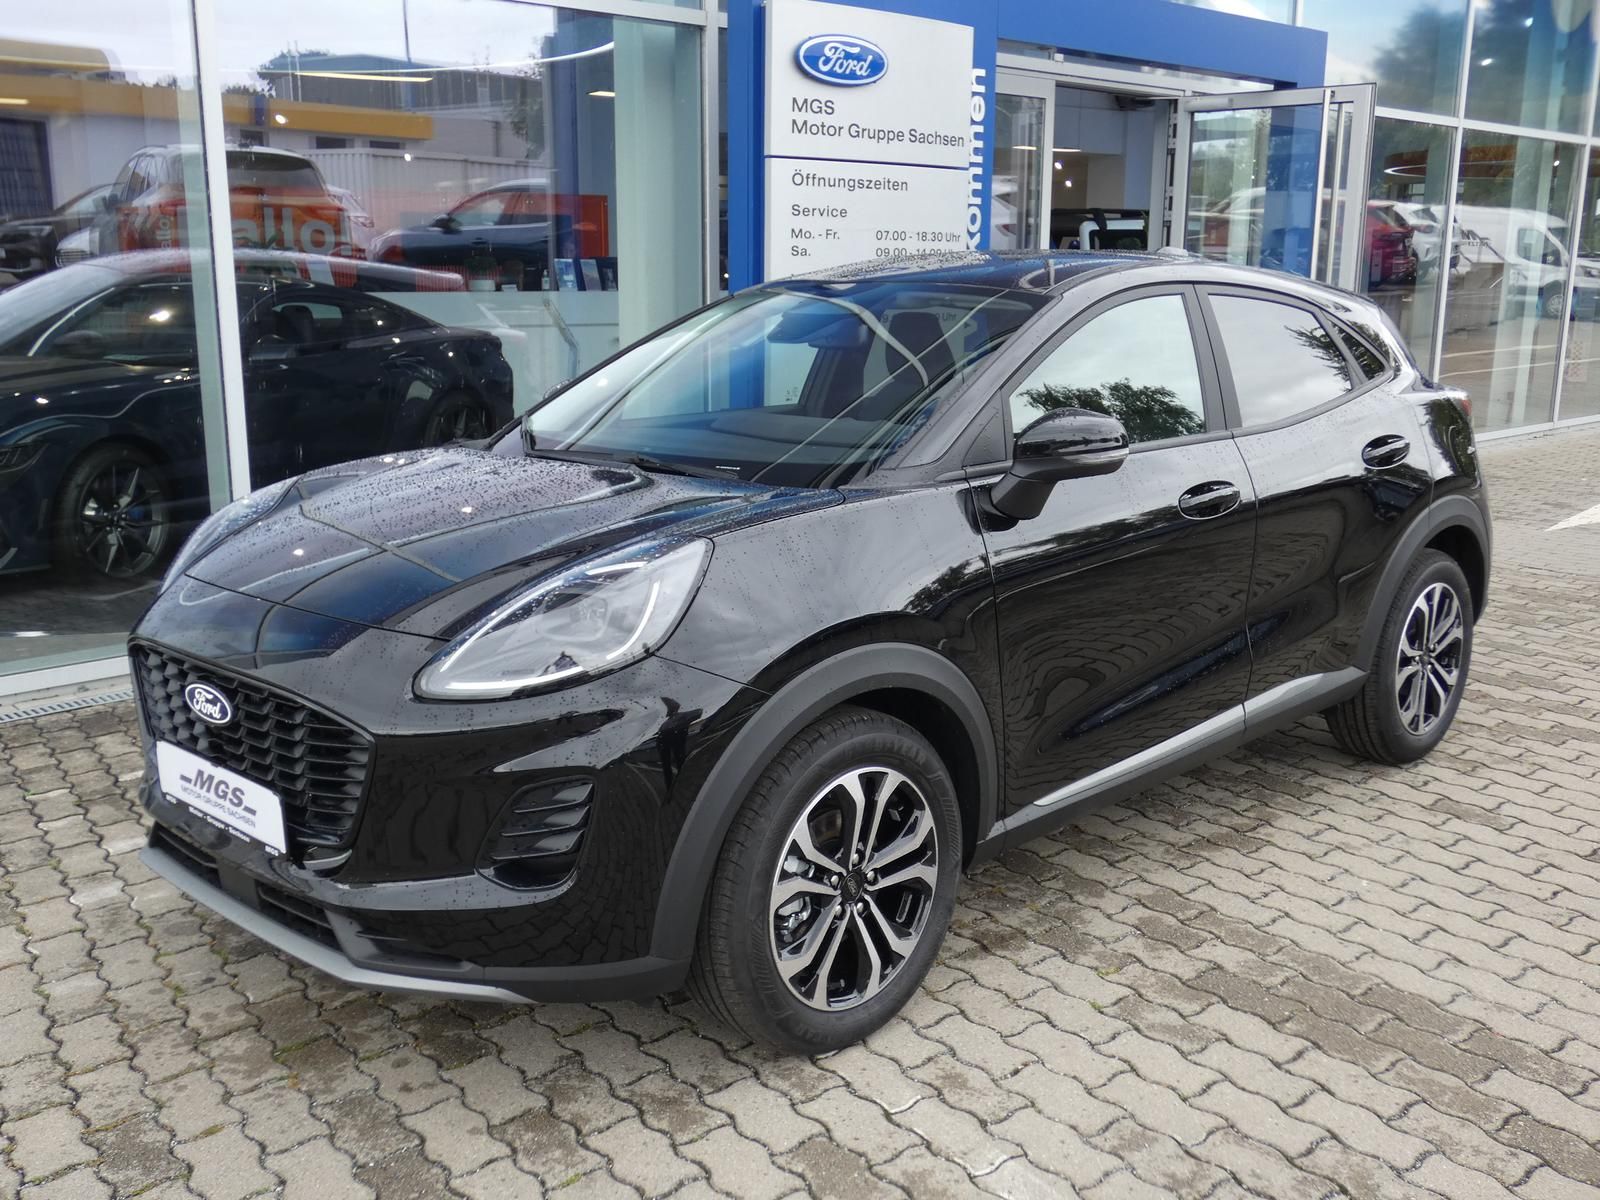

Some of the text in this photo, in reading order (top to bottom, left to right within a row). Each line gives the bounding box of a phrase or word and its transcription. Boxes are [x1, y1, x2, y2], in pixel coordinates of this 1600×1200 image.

[818, 42, 874, 77] Ford
[791, 96, 836, 115] MGS
[791, 119, 965, 148] Motor Gruppe Sachsen
[791, 169, 909, 192] Öffnungszeiten
[791, 204, 848, 218] Service
[790, 228, 815, 240] Mo.
[824, 228, 841, 241] Fr.
[875, 230, 907, 242] 07.00
[915, 231, 944, 243] 18.30
[945, 232, 961, 244] Uhr
[790, 245, 812, 258] Sa.
[875, 247, 907, 259] 09.00
[193, 688, 222, 720] Ford
[193, 769, 246, 807] MGS
